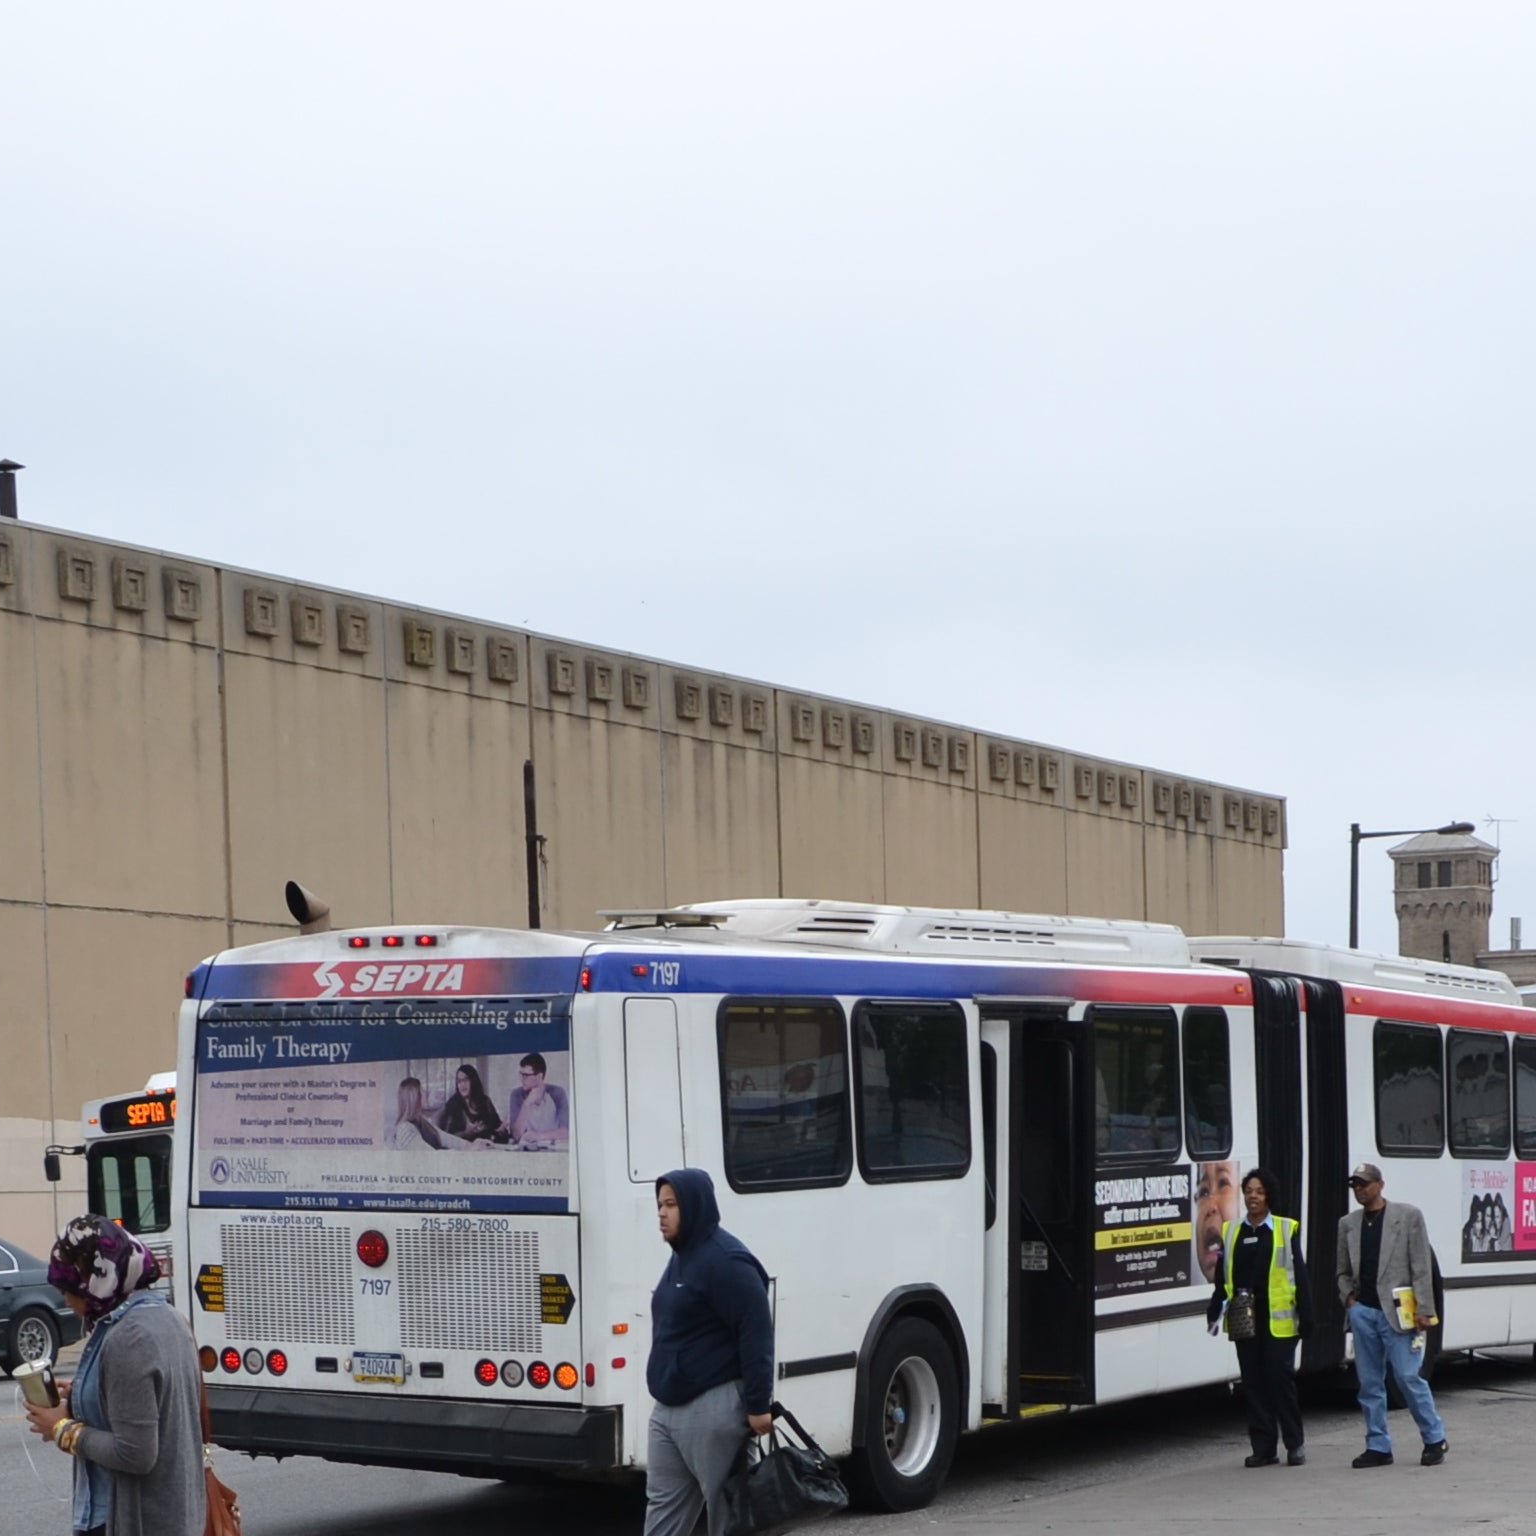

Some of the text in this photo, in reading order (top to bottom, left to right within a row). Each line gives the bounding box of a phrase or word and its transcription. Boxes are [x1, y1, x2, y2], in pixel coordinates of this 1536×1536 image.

[350, 964, 464, 992] SEPTA
[650, 962, 680, 986] 7197
[207, 1001, 552, 1030] Choose La Salle for Counseling and
[207, 1035, 352, 1063] Family Therapy
[211, 1081, 239, 1089] Advance
[241, 1082, 257, 1090] your
[283, 1080, 299, 1088] with
[307, 1080, 338, 1088] Master's
[340, 1080, 366, 1089] Degree
[236, 1093, 349, 1103] Professional Clinical Counseling
[127, 1101, 166, 1125] SEPTA
[240, 1118, 344, 1128] Marriage and Family Therapy
[291, 1137, 336, 1145] ACCELERATED
[231, 1157, 268, 1170] LASALLE
[231, 1171, 290, 1184] UNIVERSITY
[321, 1175, 562, 1186] PHILADELPHIA BUCKS COUNTY MONTGOMERY COUNTY
[1523, 1177, 1532, 1192] NO
[1095, 1175, 1189, 1205] SECONDHAND SMOKE KIDS
[241, 1213, 323, 1228] www.septa.org
[421, 1217, 509, 1231] 215-580-7800
[360, 1279, 391, 1296] 7197
